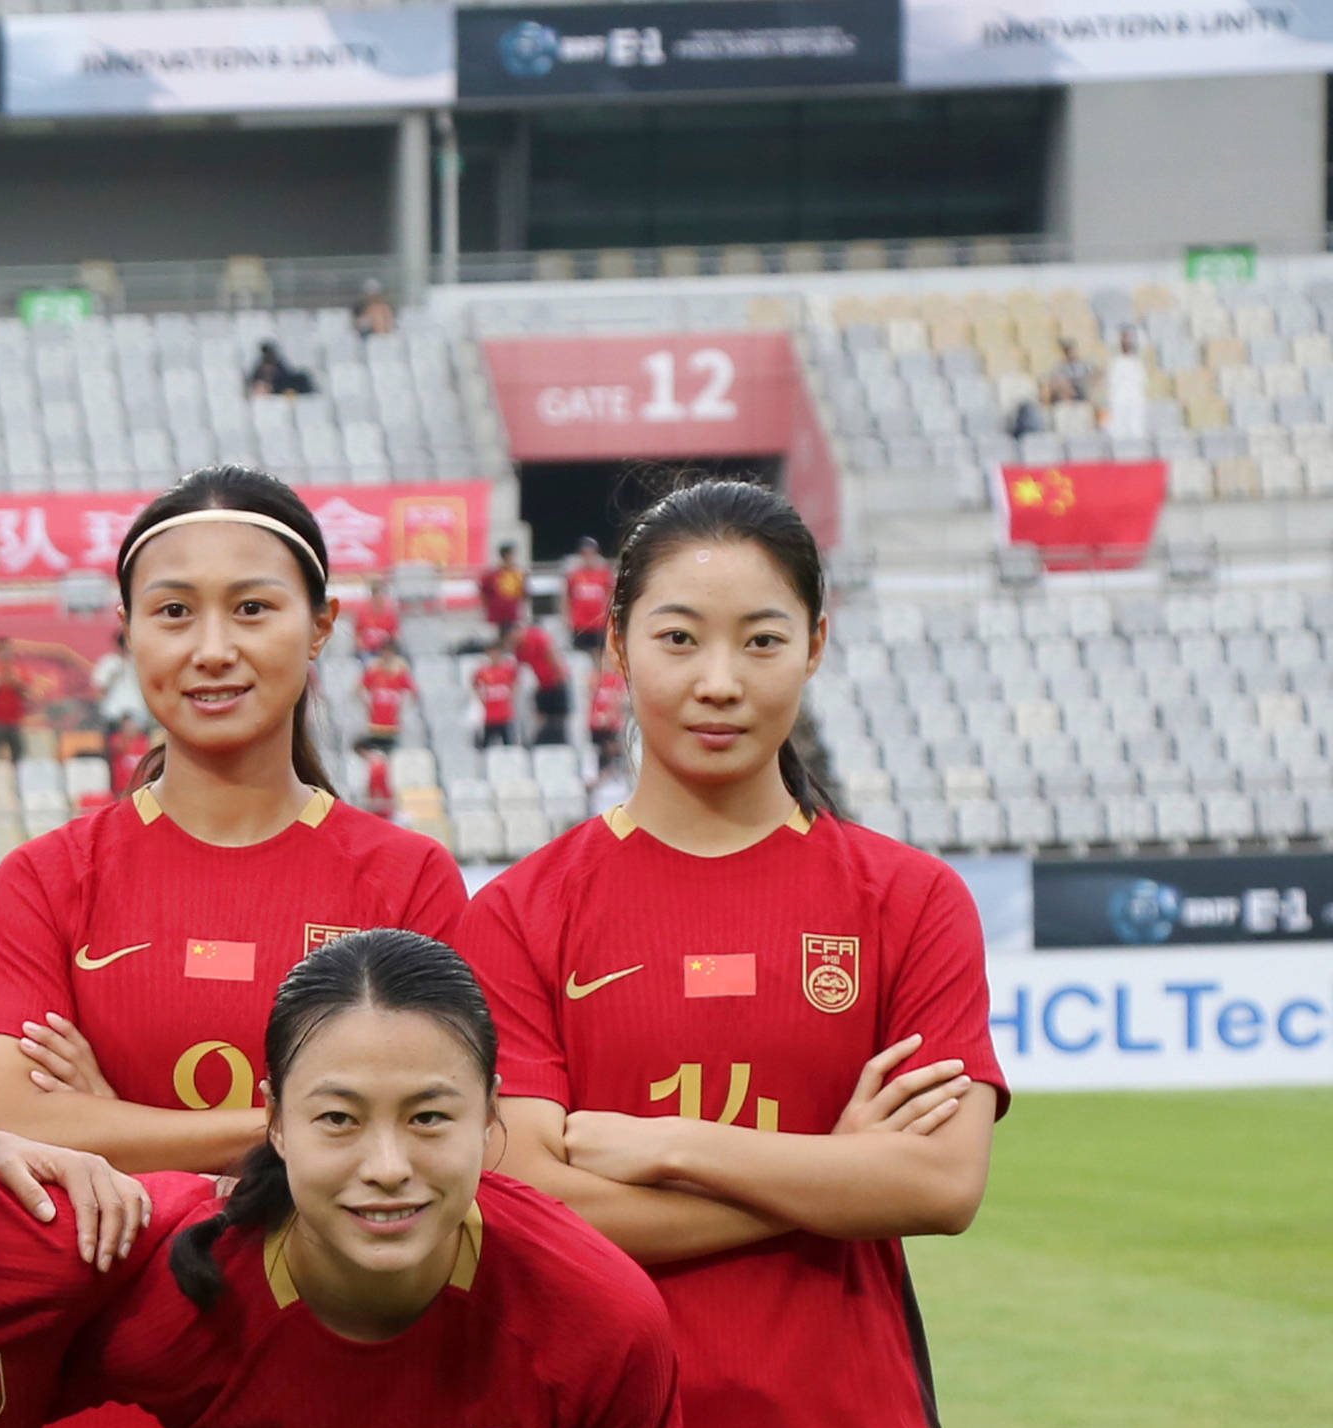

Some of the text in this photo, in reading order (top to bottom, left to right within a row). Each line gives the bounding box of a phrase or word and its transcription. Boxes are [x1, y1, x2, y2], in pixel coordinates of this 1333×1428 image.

[536, 347, 738, 426] GATE 12
[310, 928, 345, 944] CF
[808, 938, 853, 956] CFA
